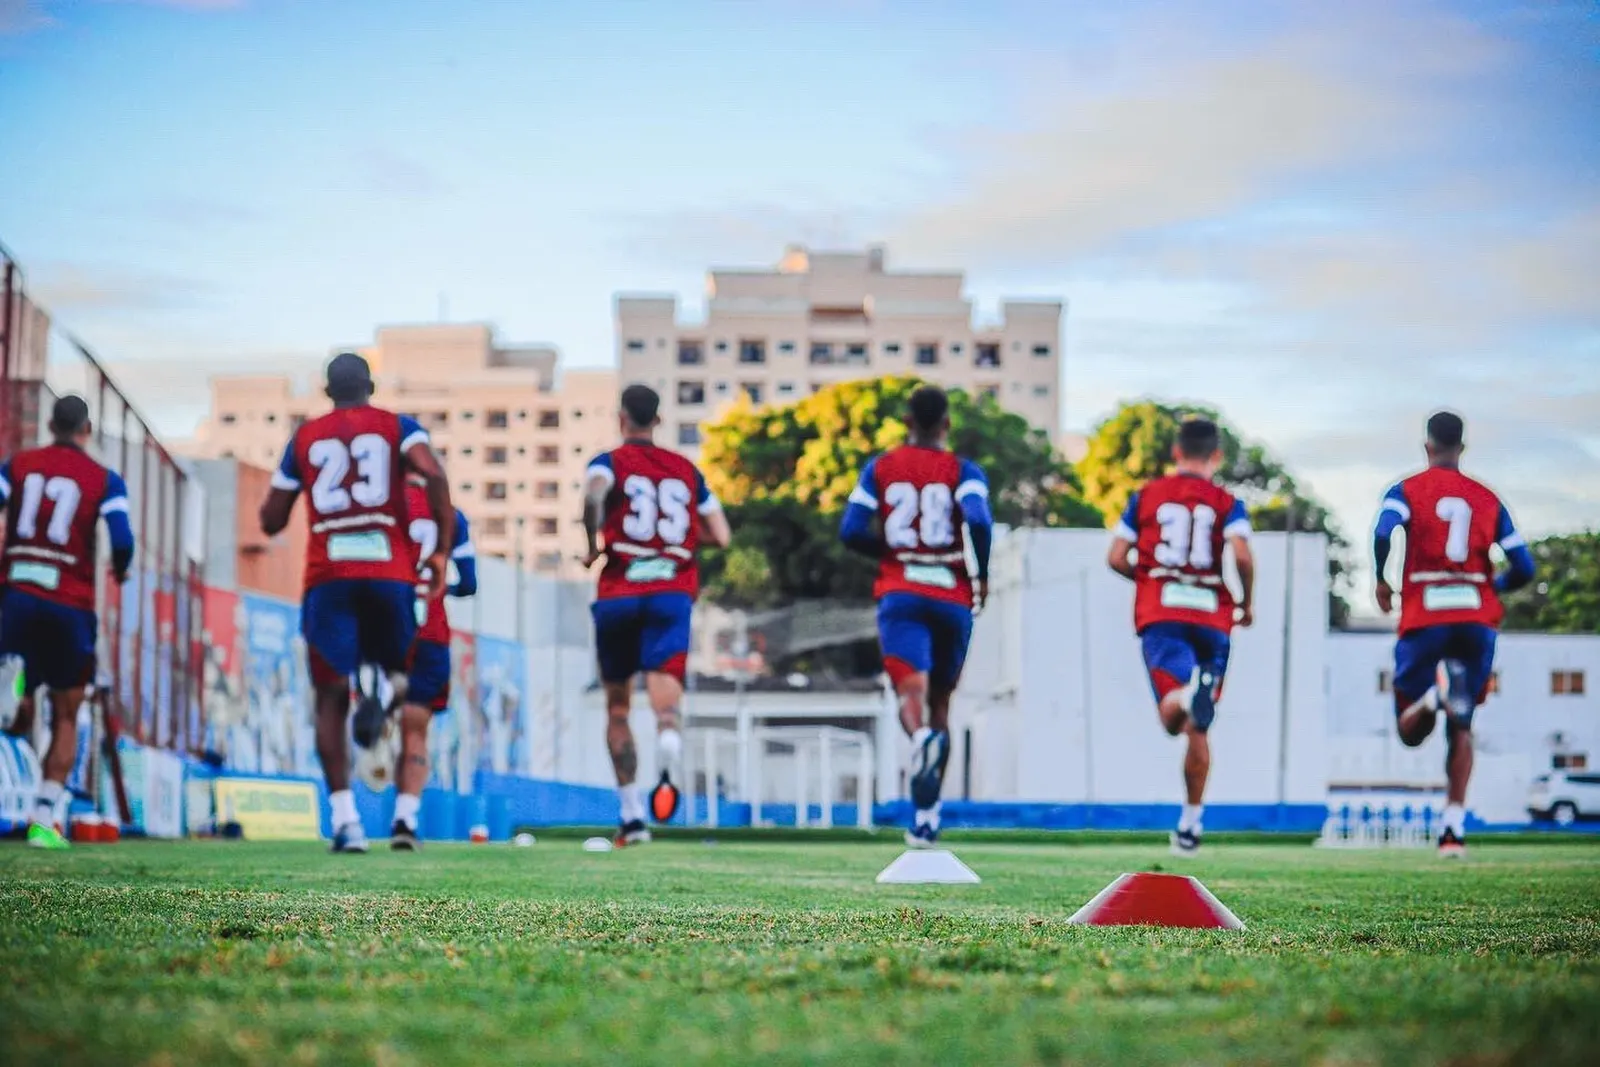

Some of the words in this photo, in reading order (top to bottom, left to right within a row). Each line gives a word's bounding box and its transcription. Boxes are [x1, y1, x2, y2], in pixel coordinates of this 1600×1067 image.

[16, 472, 82, 545] 17
[308, 433, 391, 514] 23
[623, 474, 691, 545] 35
[885, 481, 954, 548] 28
[1154, 502, 1217, 569] 31
